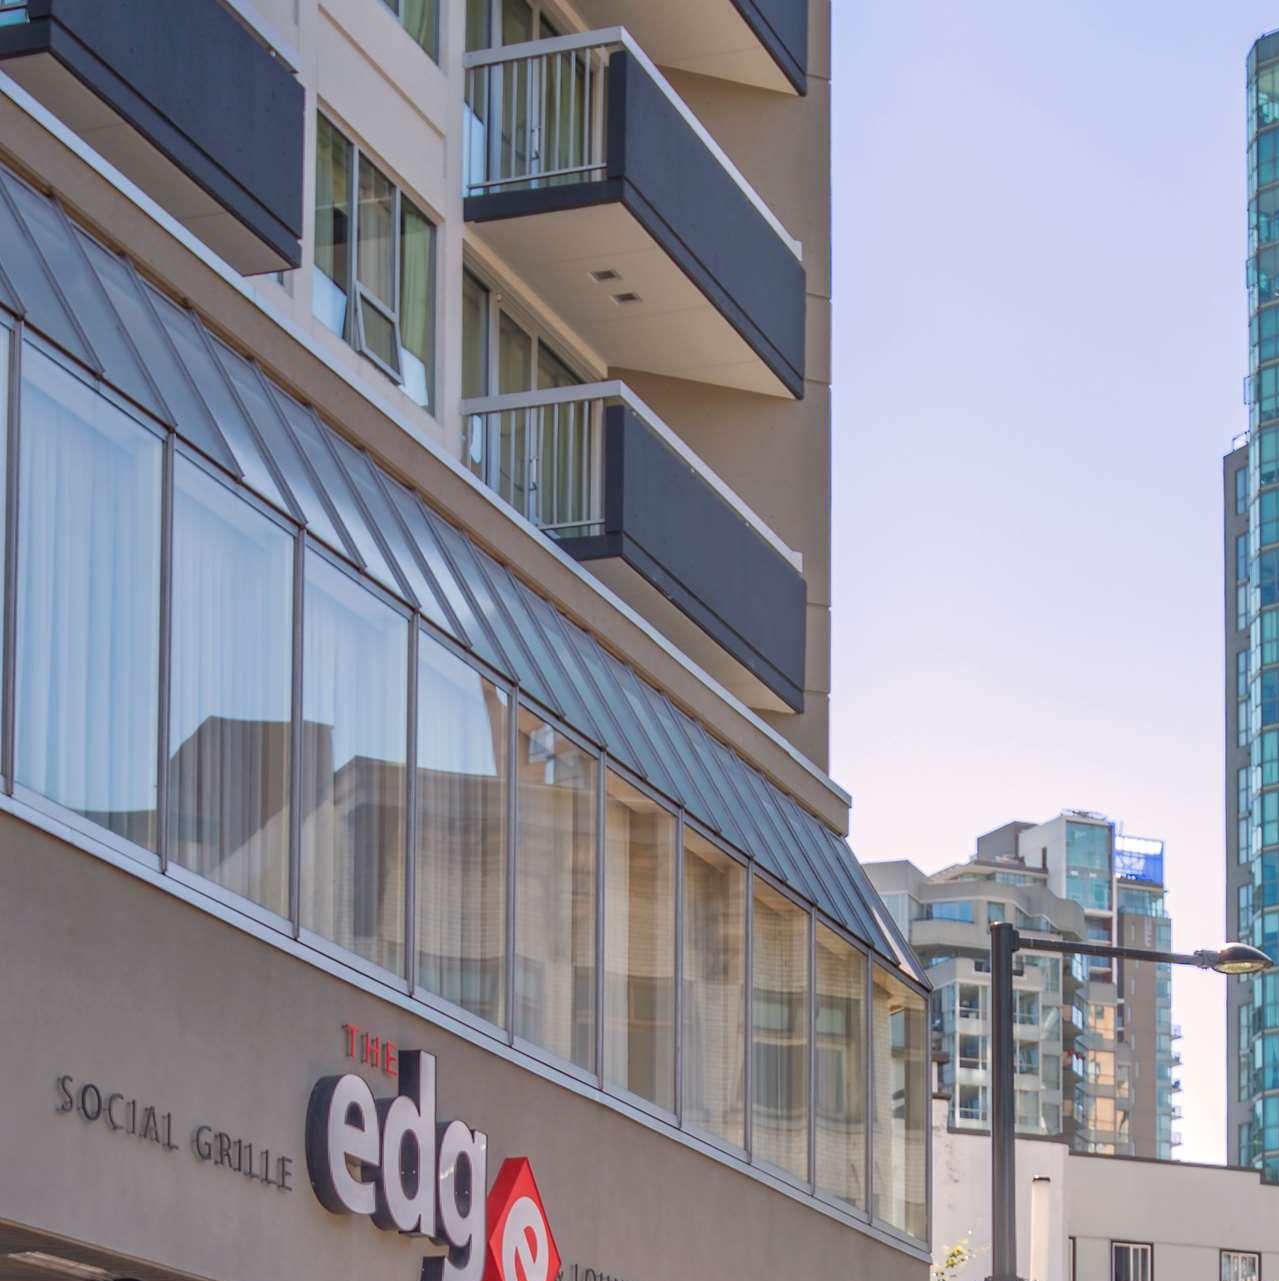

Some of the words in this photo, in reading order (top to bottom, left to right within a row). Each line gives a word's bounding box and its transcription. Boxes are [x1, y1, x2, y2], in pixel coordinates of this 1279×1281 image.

[344, 1023, 398, 1077] THE
[56, 1074, 179, 1151] SOCIAL
[194, 1125, 294, 1192] GRILLE
